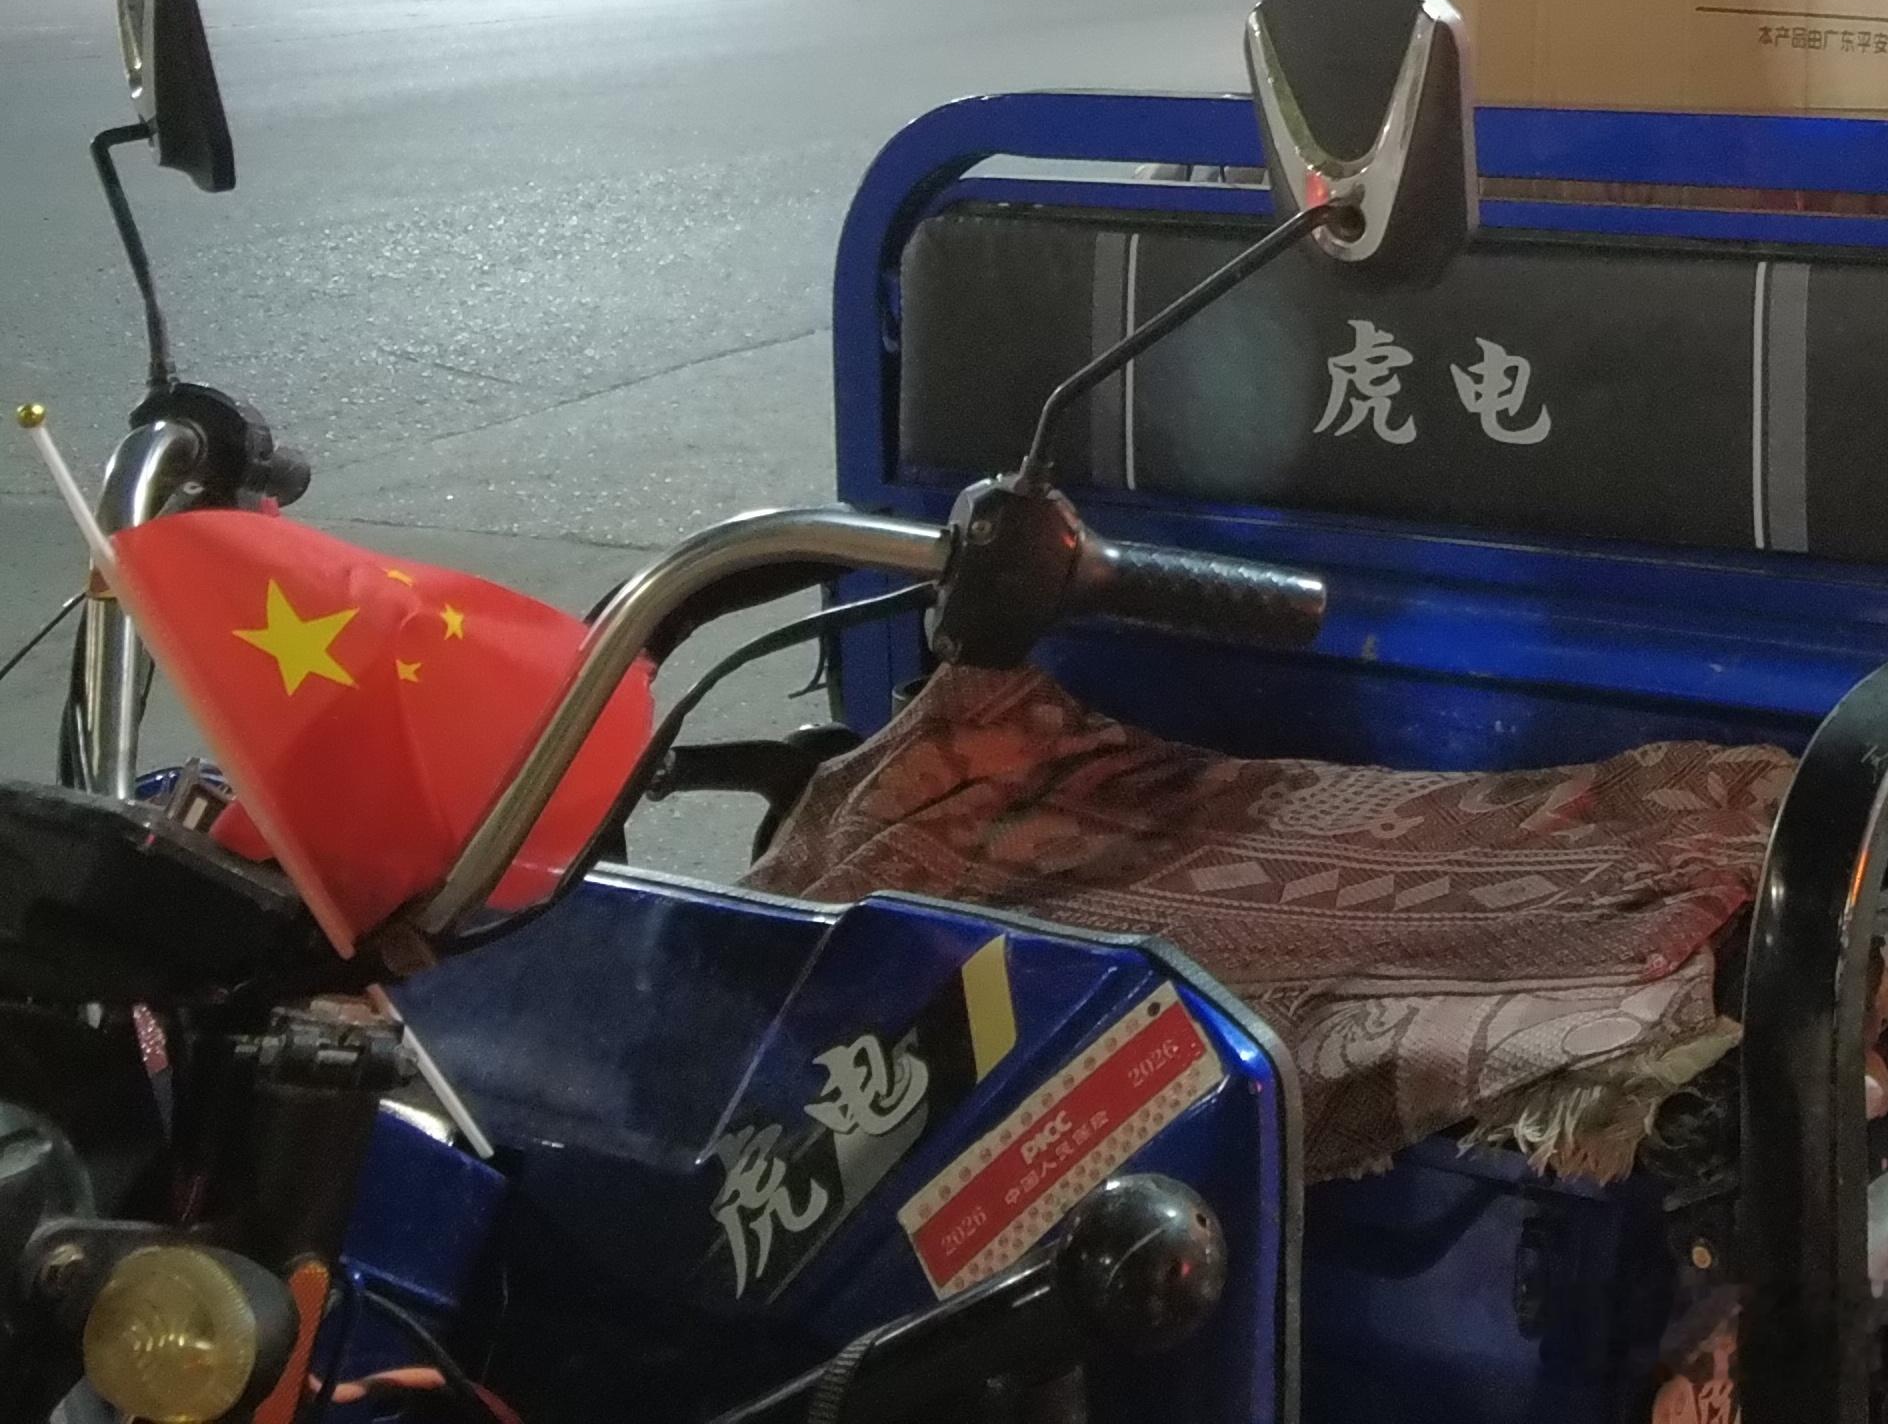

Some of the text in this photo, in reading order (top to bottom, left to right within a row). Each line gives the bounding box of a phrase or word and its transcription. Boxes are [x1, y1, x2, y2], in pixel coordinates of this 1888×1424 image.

[1312, 319, 1552, 445] 虎电
[1127, 1038, 1180, 1088] 2026
[1020, 1109, 1073, 1165] PICC
[709, 1034, 929, 1301] 虎电
[940, 1206, 988, 1256] 2026
